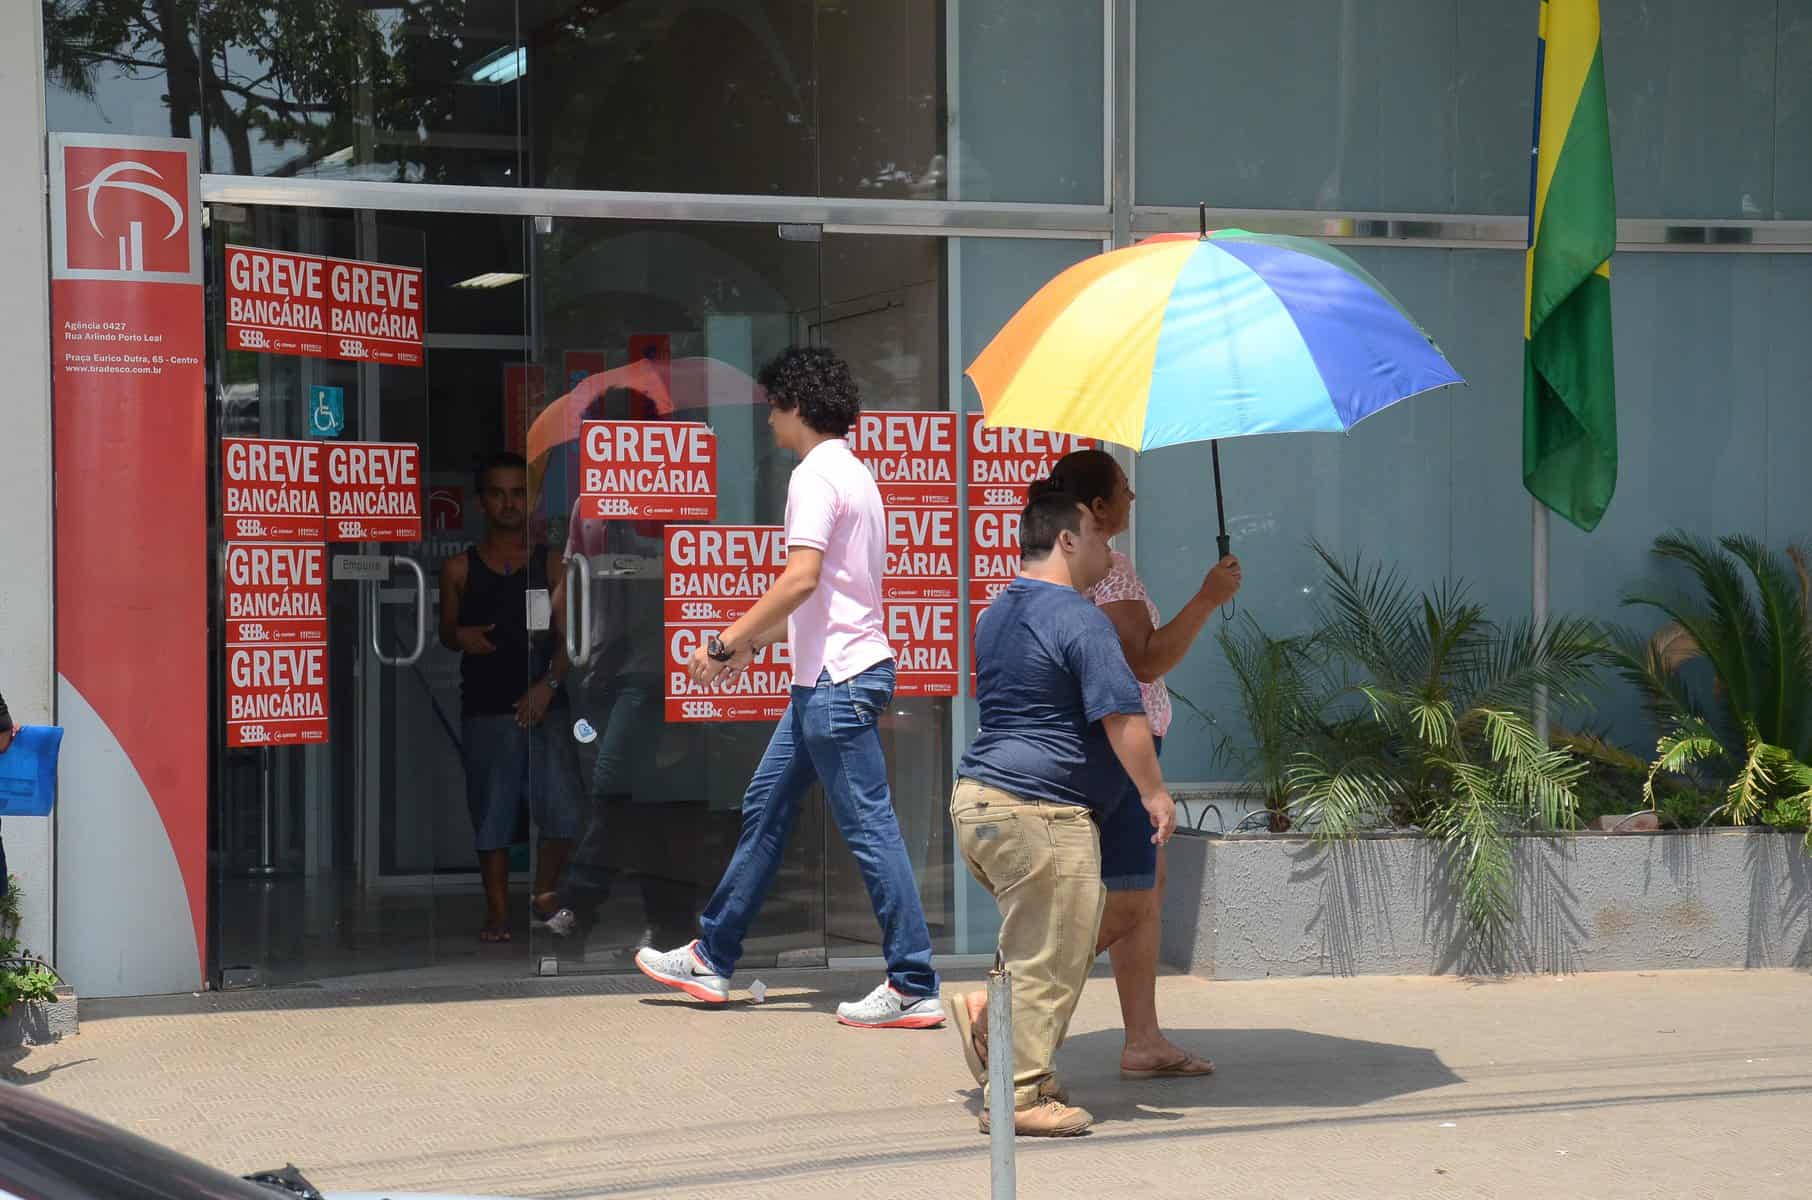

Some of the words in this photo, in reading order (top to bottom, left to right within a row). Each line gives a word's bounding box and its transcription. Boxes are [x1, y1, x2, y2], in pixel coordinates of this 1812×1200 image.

[230, 253, 322, 299] GREVE
[332, 265, 418, 310] GREVE
[103, 322, 126, 330] 0427
[230, 296, 322, 330] BANCÁRIA
[332, 308, 418, 339] BANCÁRIA
[65, 332, 82, 340] Rua
[85, 333, 116, 341] Arlindo
[144, 334, 162, 342] Leal
[65, 365, 161, 374] www.bradesco.com.br
[94, 354, 121, 362] Eurico
[171, 356, 199, 364] Centro
[586, 426, 710, 463] GREVE
[227, 443, 319, 482] GREVE
[329, 448, 416, 484] GREVE
[586, 463, 710, 493] BANCÁRIA
[864, 452, 950, 480] NCÁRIA
[228, 482, 319, 513] BANCÁRIA
[330, 485, 416, 514] BANCÁRIA
[888, 511, 952, 546] EVE
[670, 530, 788, 566] GREVE
[230, 549, 322, 586] GREVE
[230, 585, 322, 616] BANCÁRIA
[888, 606, 953, 640] EVE
[231, 649, 323, 687] GREVE
[232, 686, 323, 718] BANCÁRIA
